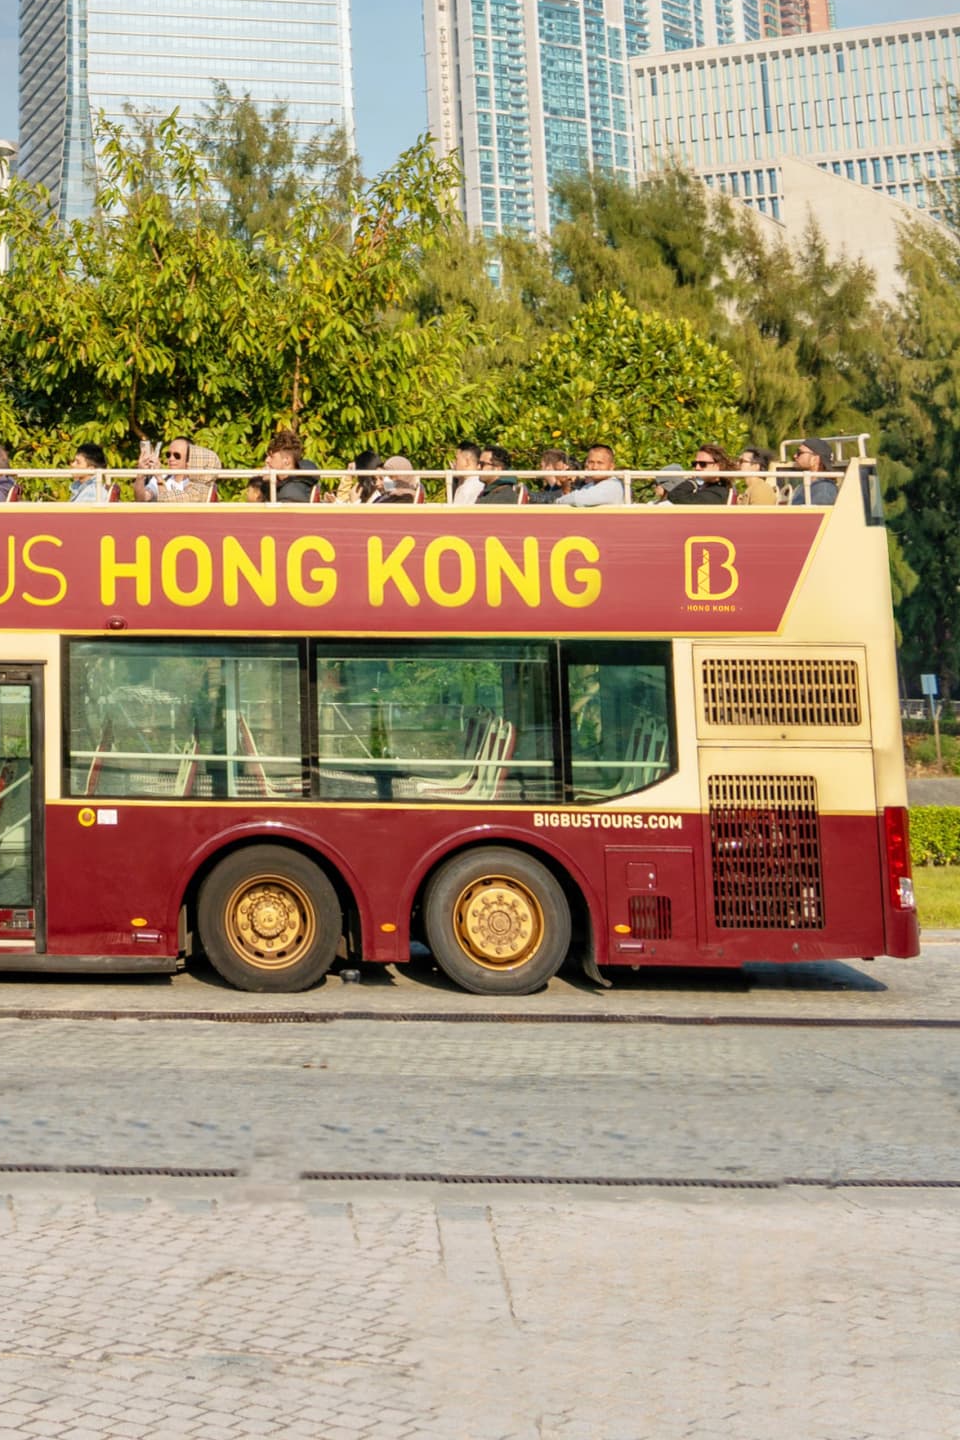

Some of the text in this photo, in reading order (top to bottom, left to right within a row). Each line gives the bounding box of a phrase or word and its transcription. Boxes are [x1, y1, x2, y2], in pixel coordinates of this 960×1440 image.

[101, 536, 337, 606] HONG
[368, 536, 602, 607] KONG
[687, 604, 736, 612] HONG KONG
[533, 813, 683, 830] BIGBUSTOURS.COM
